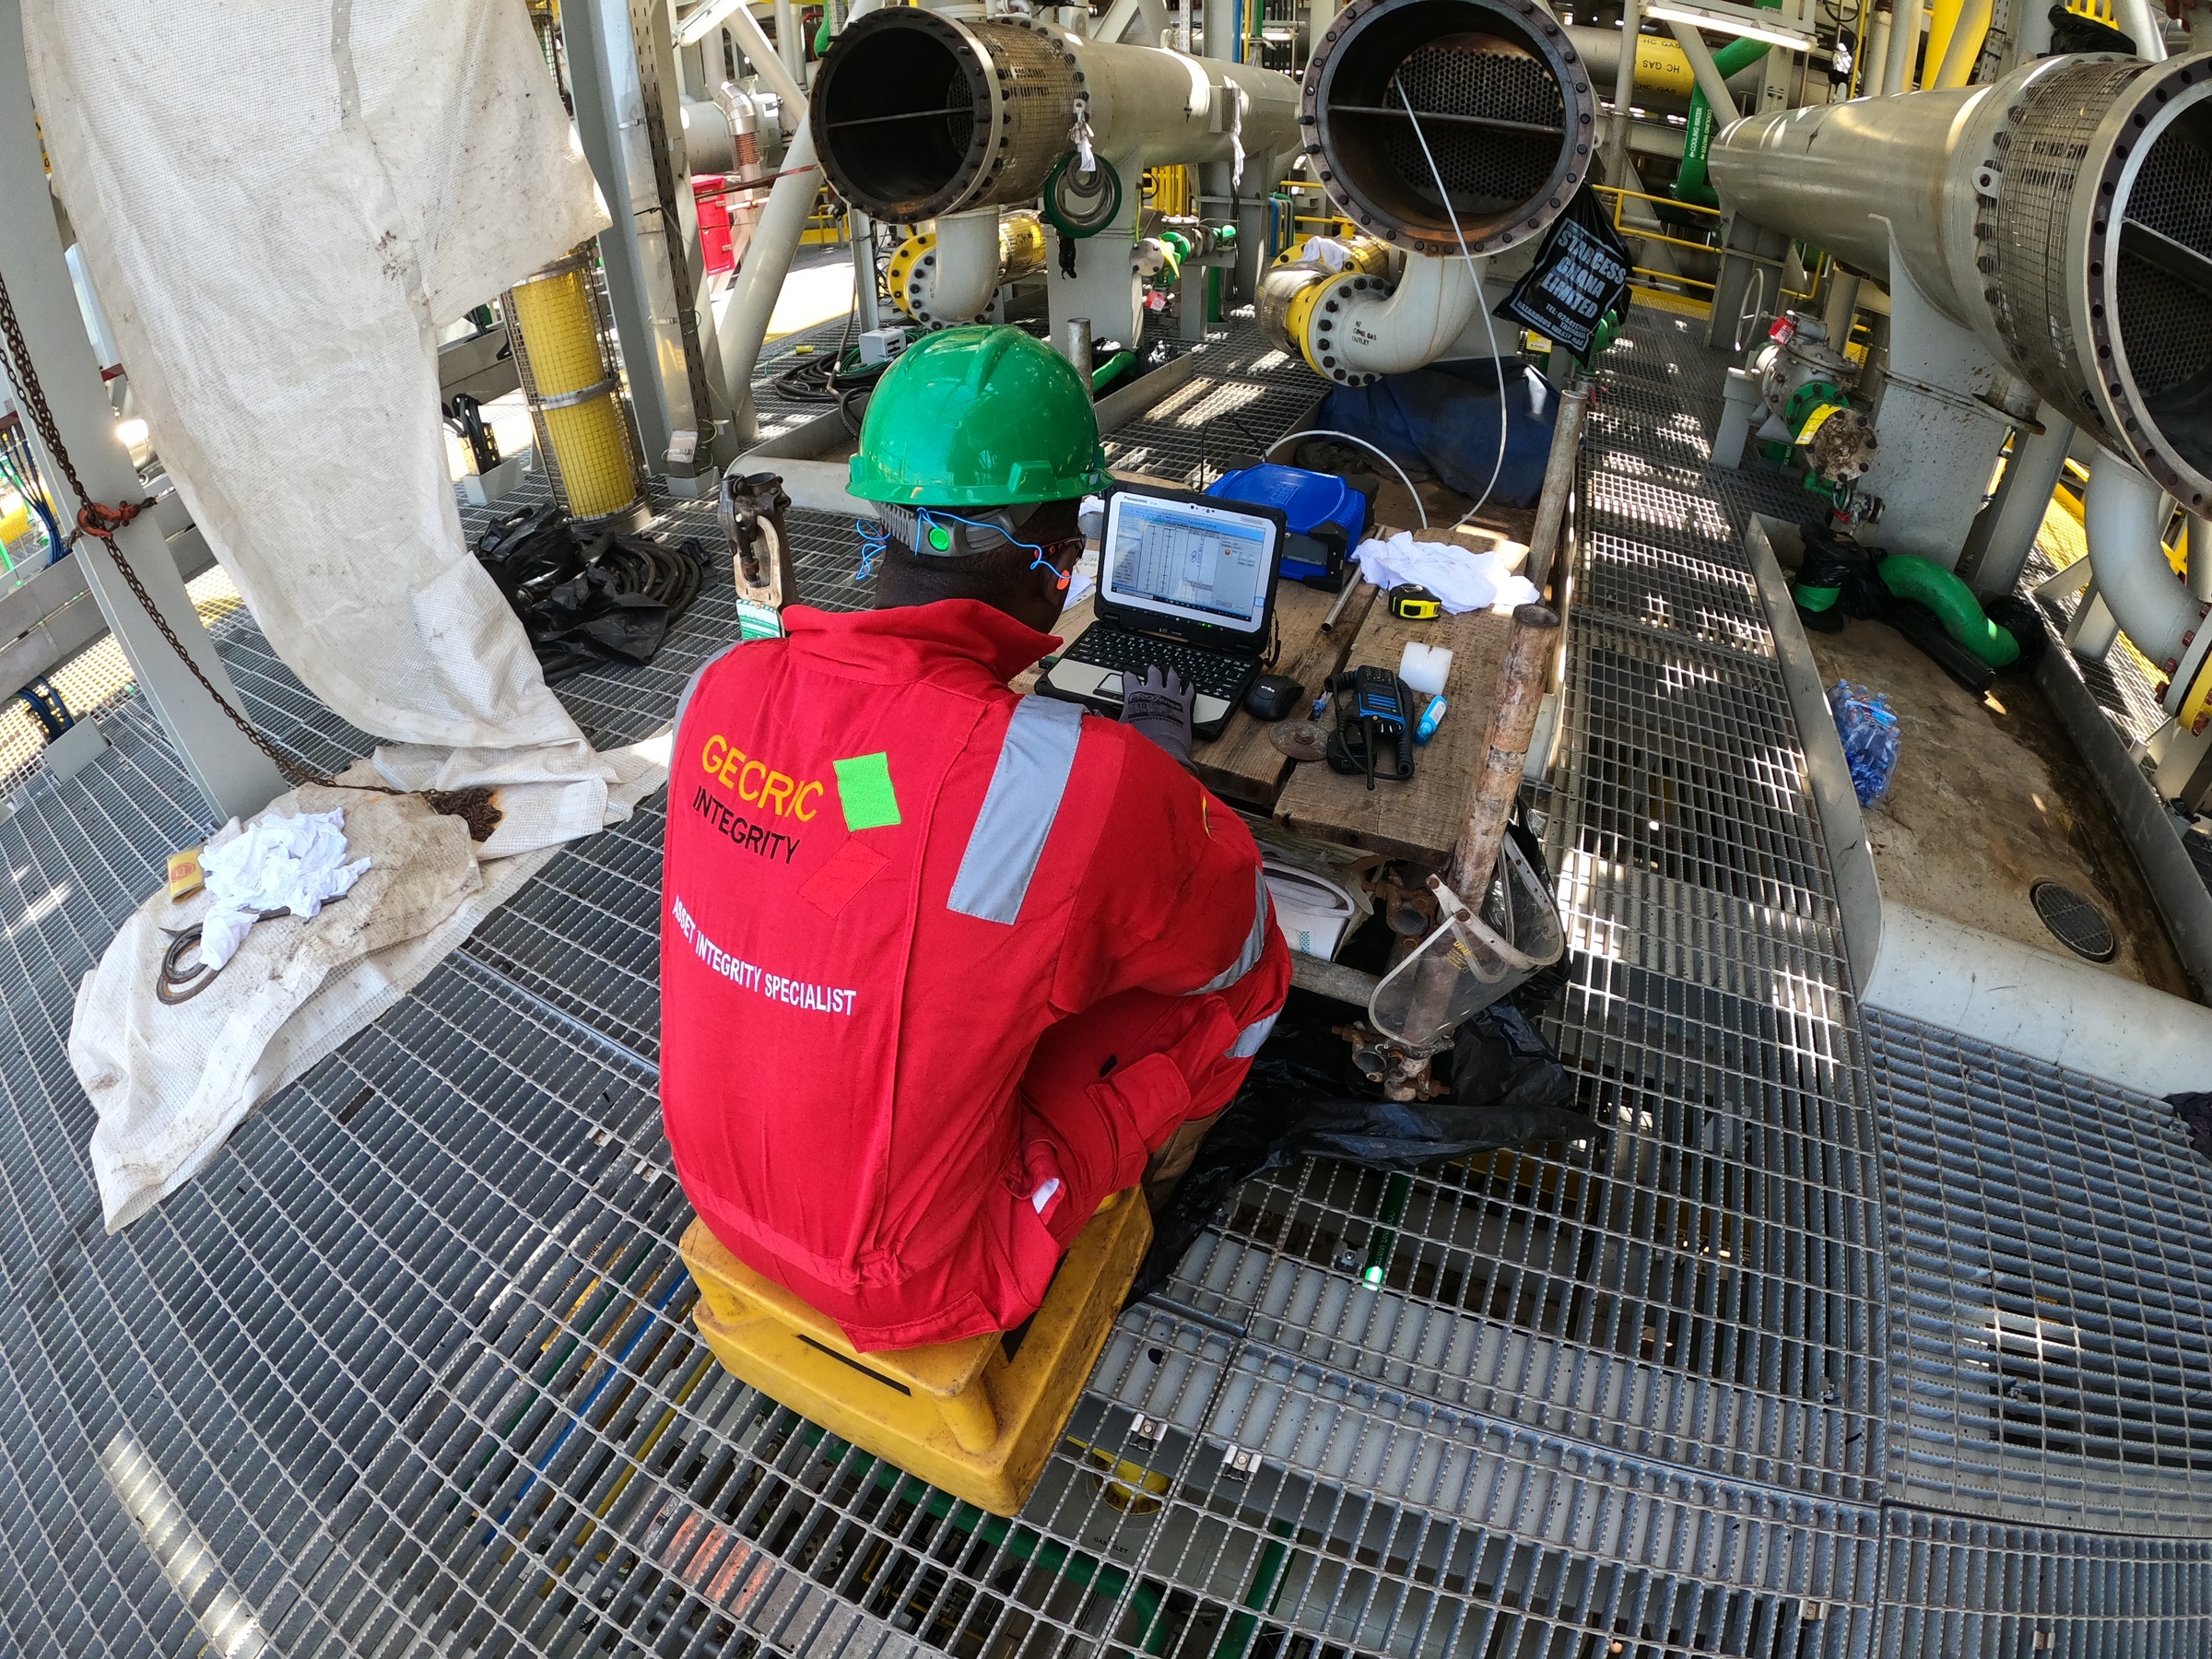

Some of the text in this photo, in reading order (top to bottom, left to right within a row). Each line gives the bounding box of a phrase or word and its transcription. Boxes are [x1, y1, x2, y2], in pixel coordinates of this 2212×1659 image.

[1642, 60, 1680, 73] HC GAS
[1690, 107, 1703, 152] COOLING WATER
[1556, 256, 1606, 298] GHANA
[1558, 230, 1626, 284] STARCESS
[1517, 300, 1551, 327] HAZARDOUS
[1541, 273, 1598, 319] LIMITED
[1352, 335, 1369, 345] OUTLET
[701, 734, 824, 822] GECRIC
[692, 785, 800, 865] INTEGRITY
[672, 894, 857, 1016] ASSET INTEGRITY SPECIALIST
[1094, 1537, 1107, 1546] GAS
